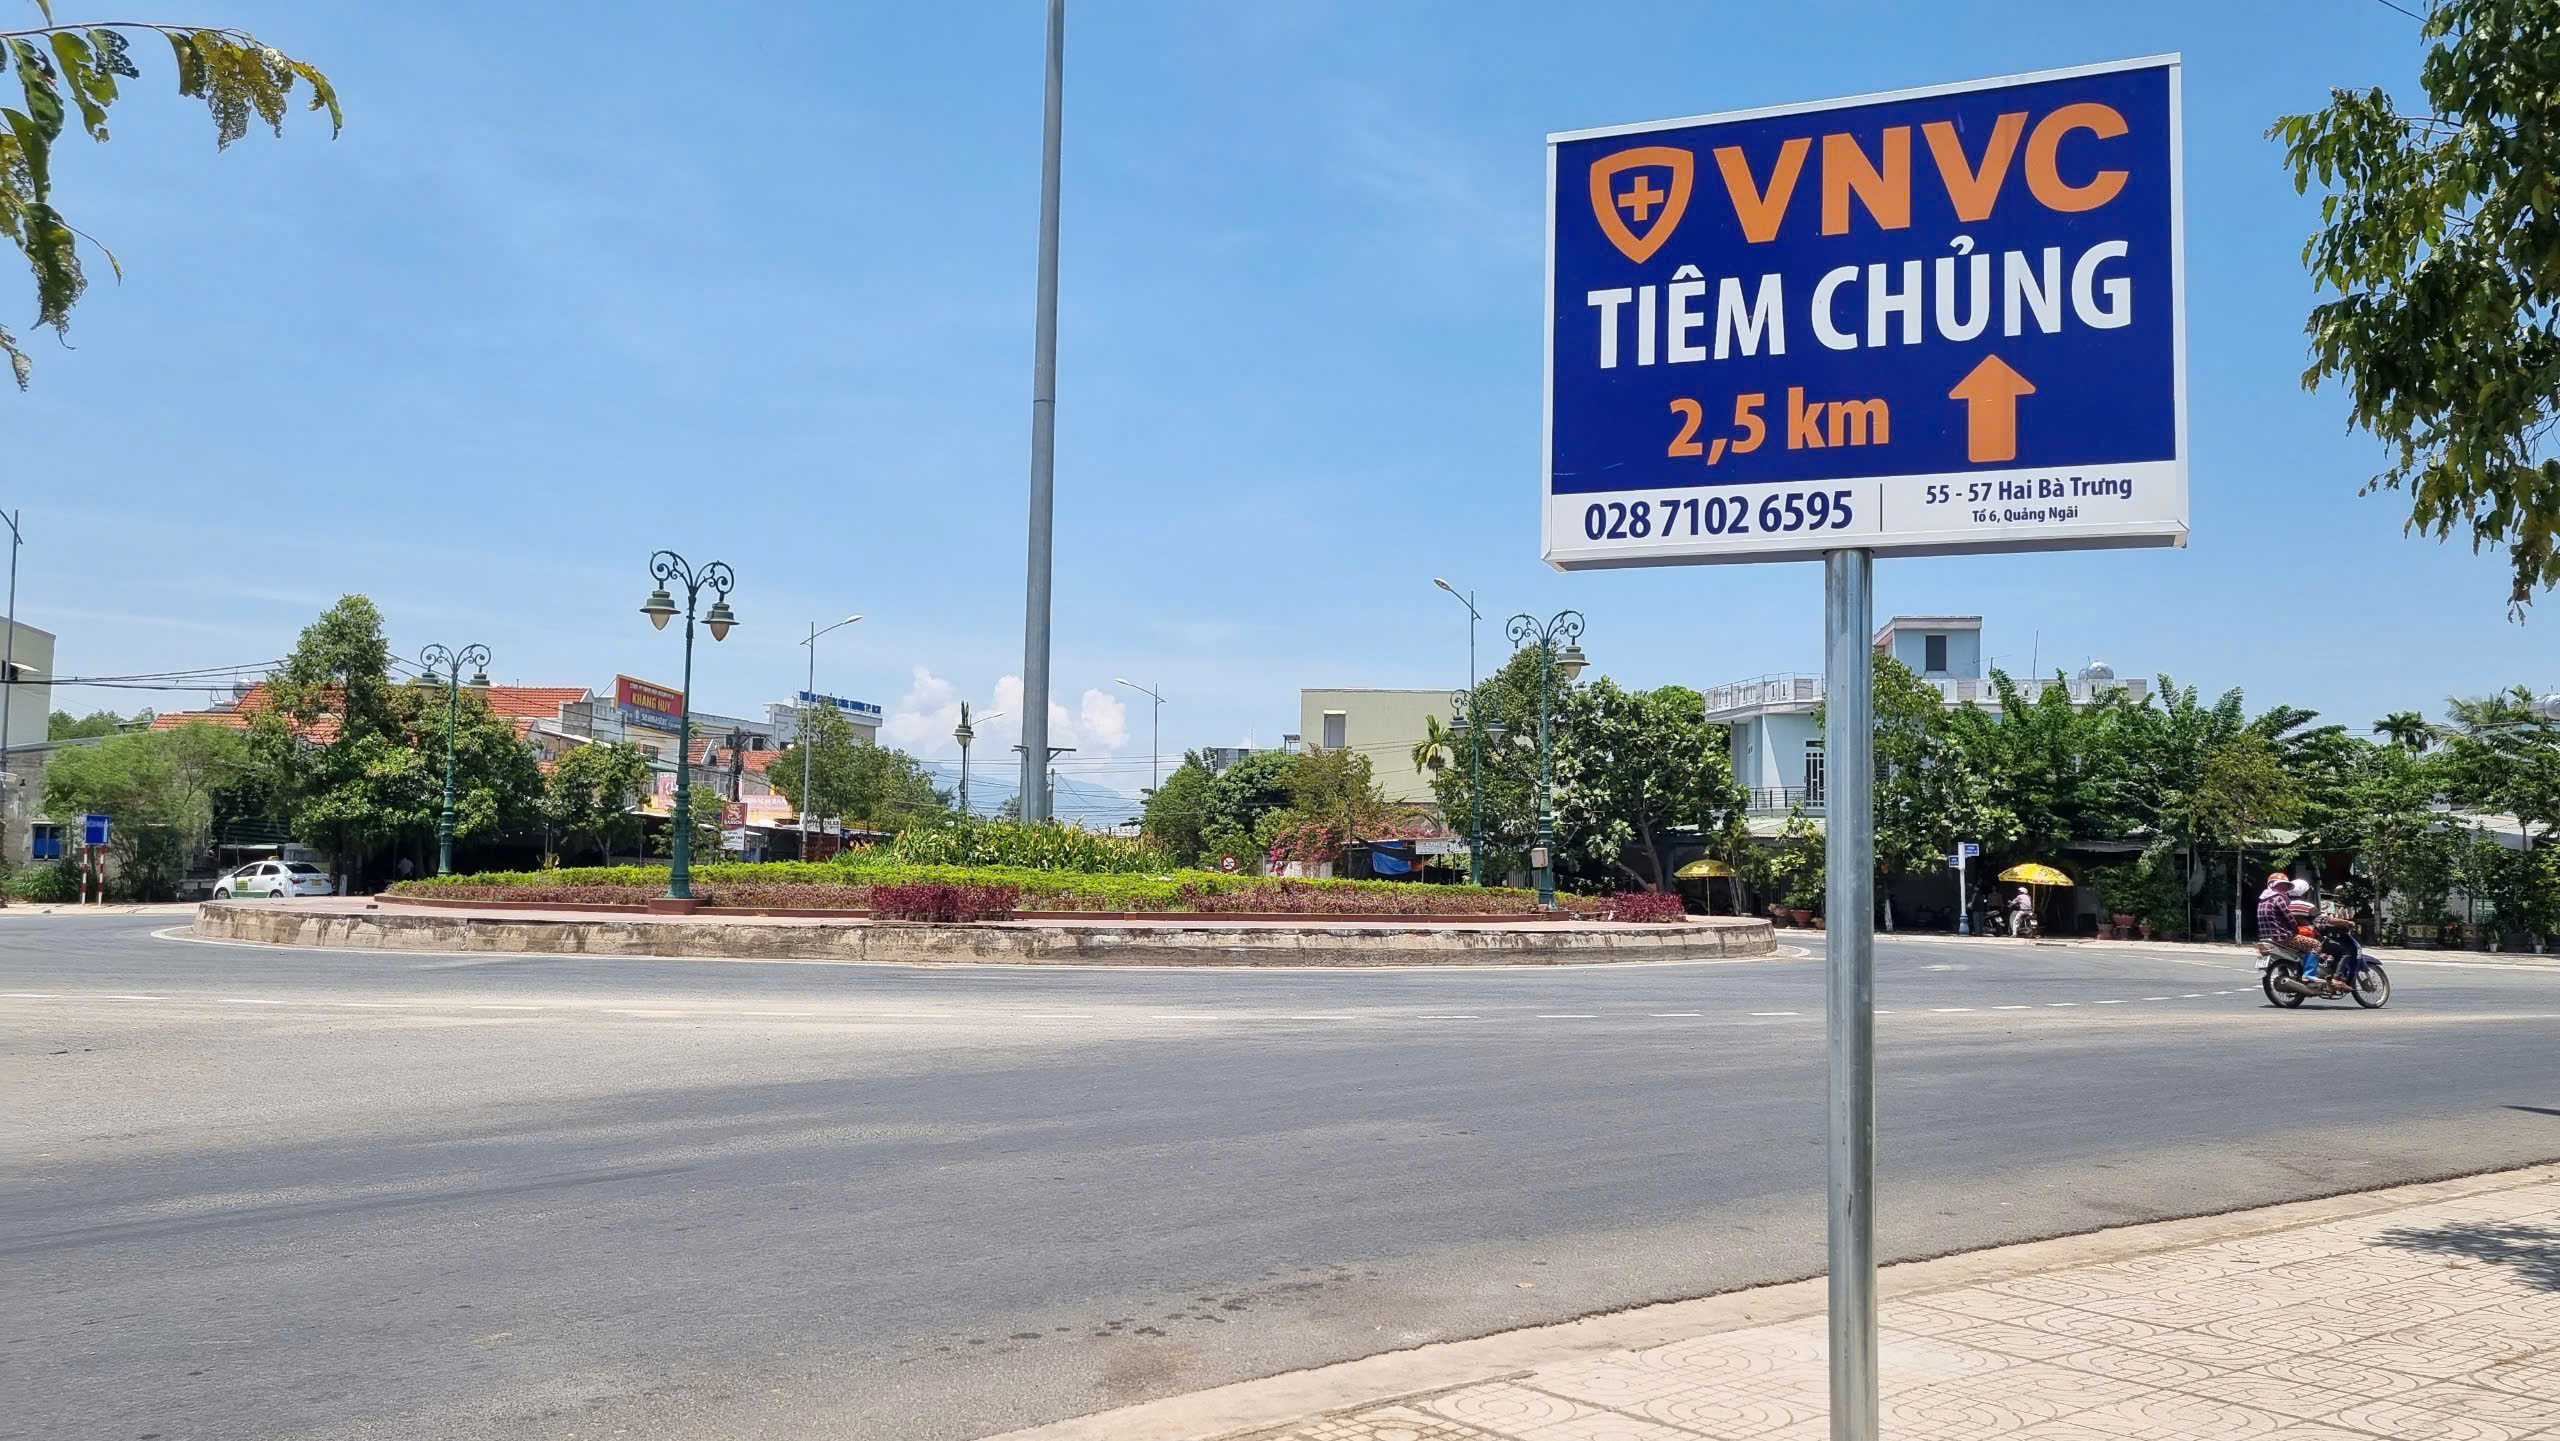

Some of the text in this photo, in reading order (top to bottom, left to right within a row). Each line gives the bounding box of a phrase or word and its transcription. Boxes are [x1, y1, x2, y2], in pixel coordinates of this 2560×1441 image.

[1714, 103, 2129, 244] VNVC
[1588, 235, 2131, 369] TIÊM CHỦNG
[1668, 387, 1889, 465] 2,5 km
[1584, 489, 1853, 541] 028 7102 6595
[1926, 484, 1950, 504] 55
[1967, 482, 1993, 502] 57
[1998, 478, 2032, 500] Hai
[2038, 477, 2065, 499] Bà
[2070, 476, 2132, 499] Trưng
[1972, 505, 2079, 523] Tổ 6, Quảng Ngãi
[632, 691, 672, 713] KHANG HUY
